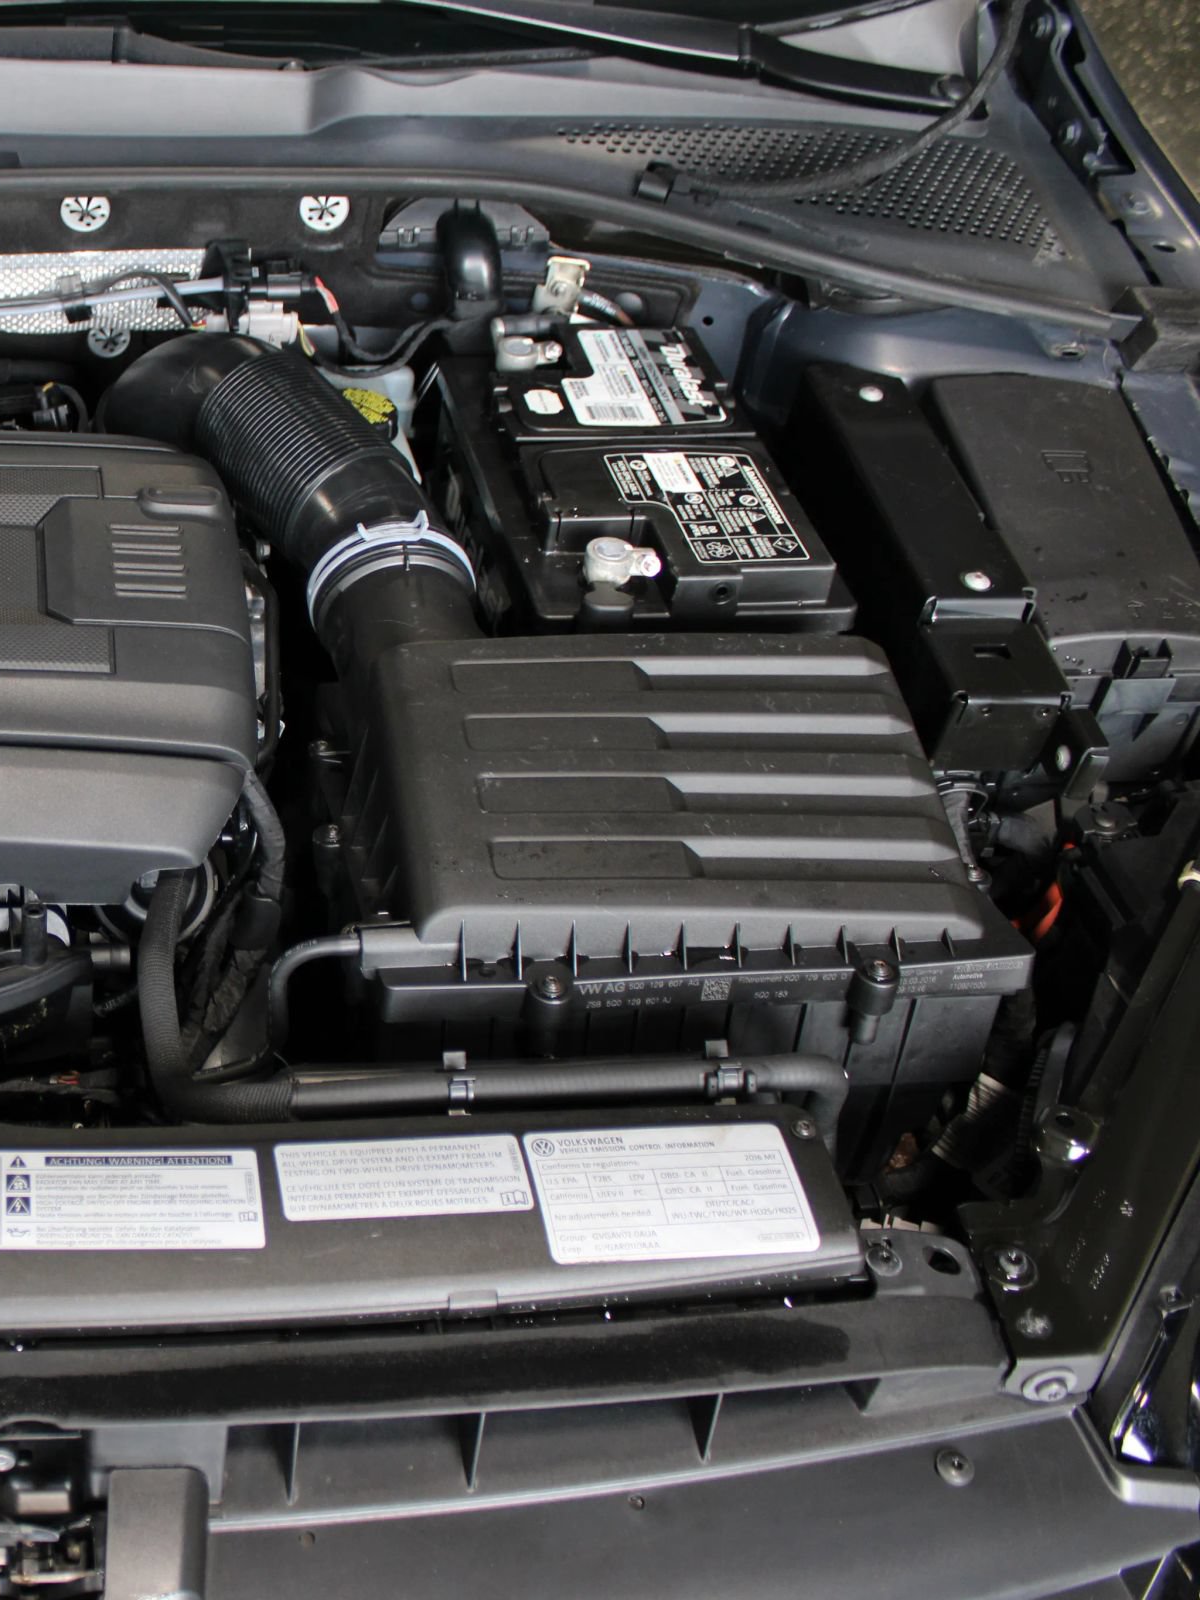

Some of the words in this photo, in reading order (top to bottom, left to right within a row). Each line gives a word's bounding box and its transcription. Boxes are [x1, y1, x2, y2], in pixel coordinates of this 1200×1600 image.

[660, 343, 713, 406] Duralast
[580, 984, 603, 995] VW
[604, 982, 625, 993] AG
[557, 1137, 624, 1147] VOLKSWAGEN
[592, 1145, 626, 1153] EMISSION
[629, 1144, 661, 1152] CONTROL
[664, 1142, 716, 1150] INFORMATION
[302, 1150, 337, 1158] VEHICLE
[350, 1148, 394, 1156] EQUIPPED
[395, 1146, 419, 1154] WITH
[429, 1144, 481, 1152] PERMANENT
[49, 1158, 105, 1166] ACHTUNG!
[108, 1157, 165, 1166] WARNING!
[167, 1156, 228, 1165] ATTENTION!
[332, 1158, 359, 1166] DRIVE
[360, 1156, 393, 1165] SYSTEM
[461, 1152, 486, 1160] FROM
[284, 1168, 320, 1177] TESTING
[322, 1168, 336, 1176] ON
[396, 1164, 420, 1173] DRIVE
[444, 1178, 455, 1186] DE
[458, 1175, 520, 1184] TRANSMISSION
[753, 1183, 788, 1191] Gasoline
